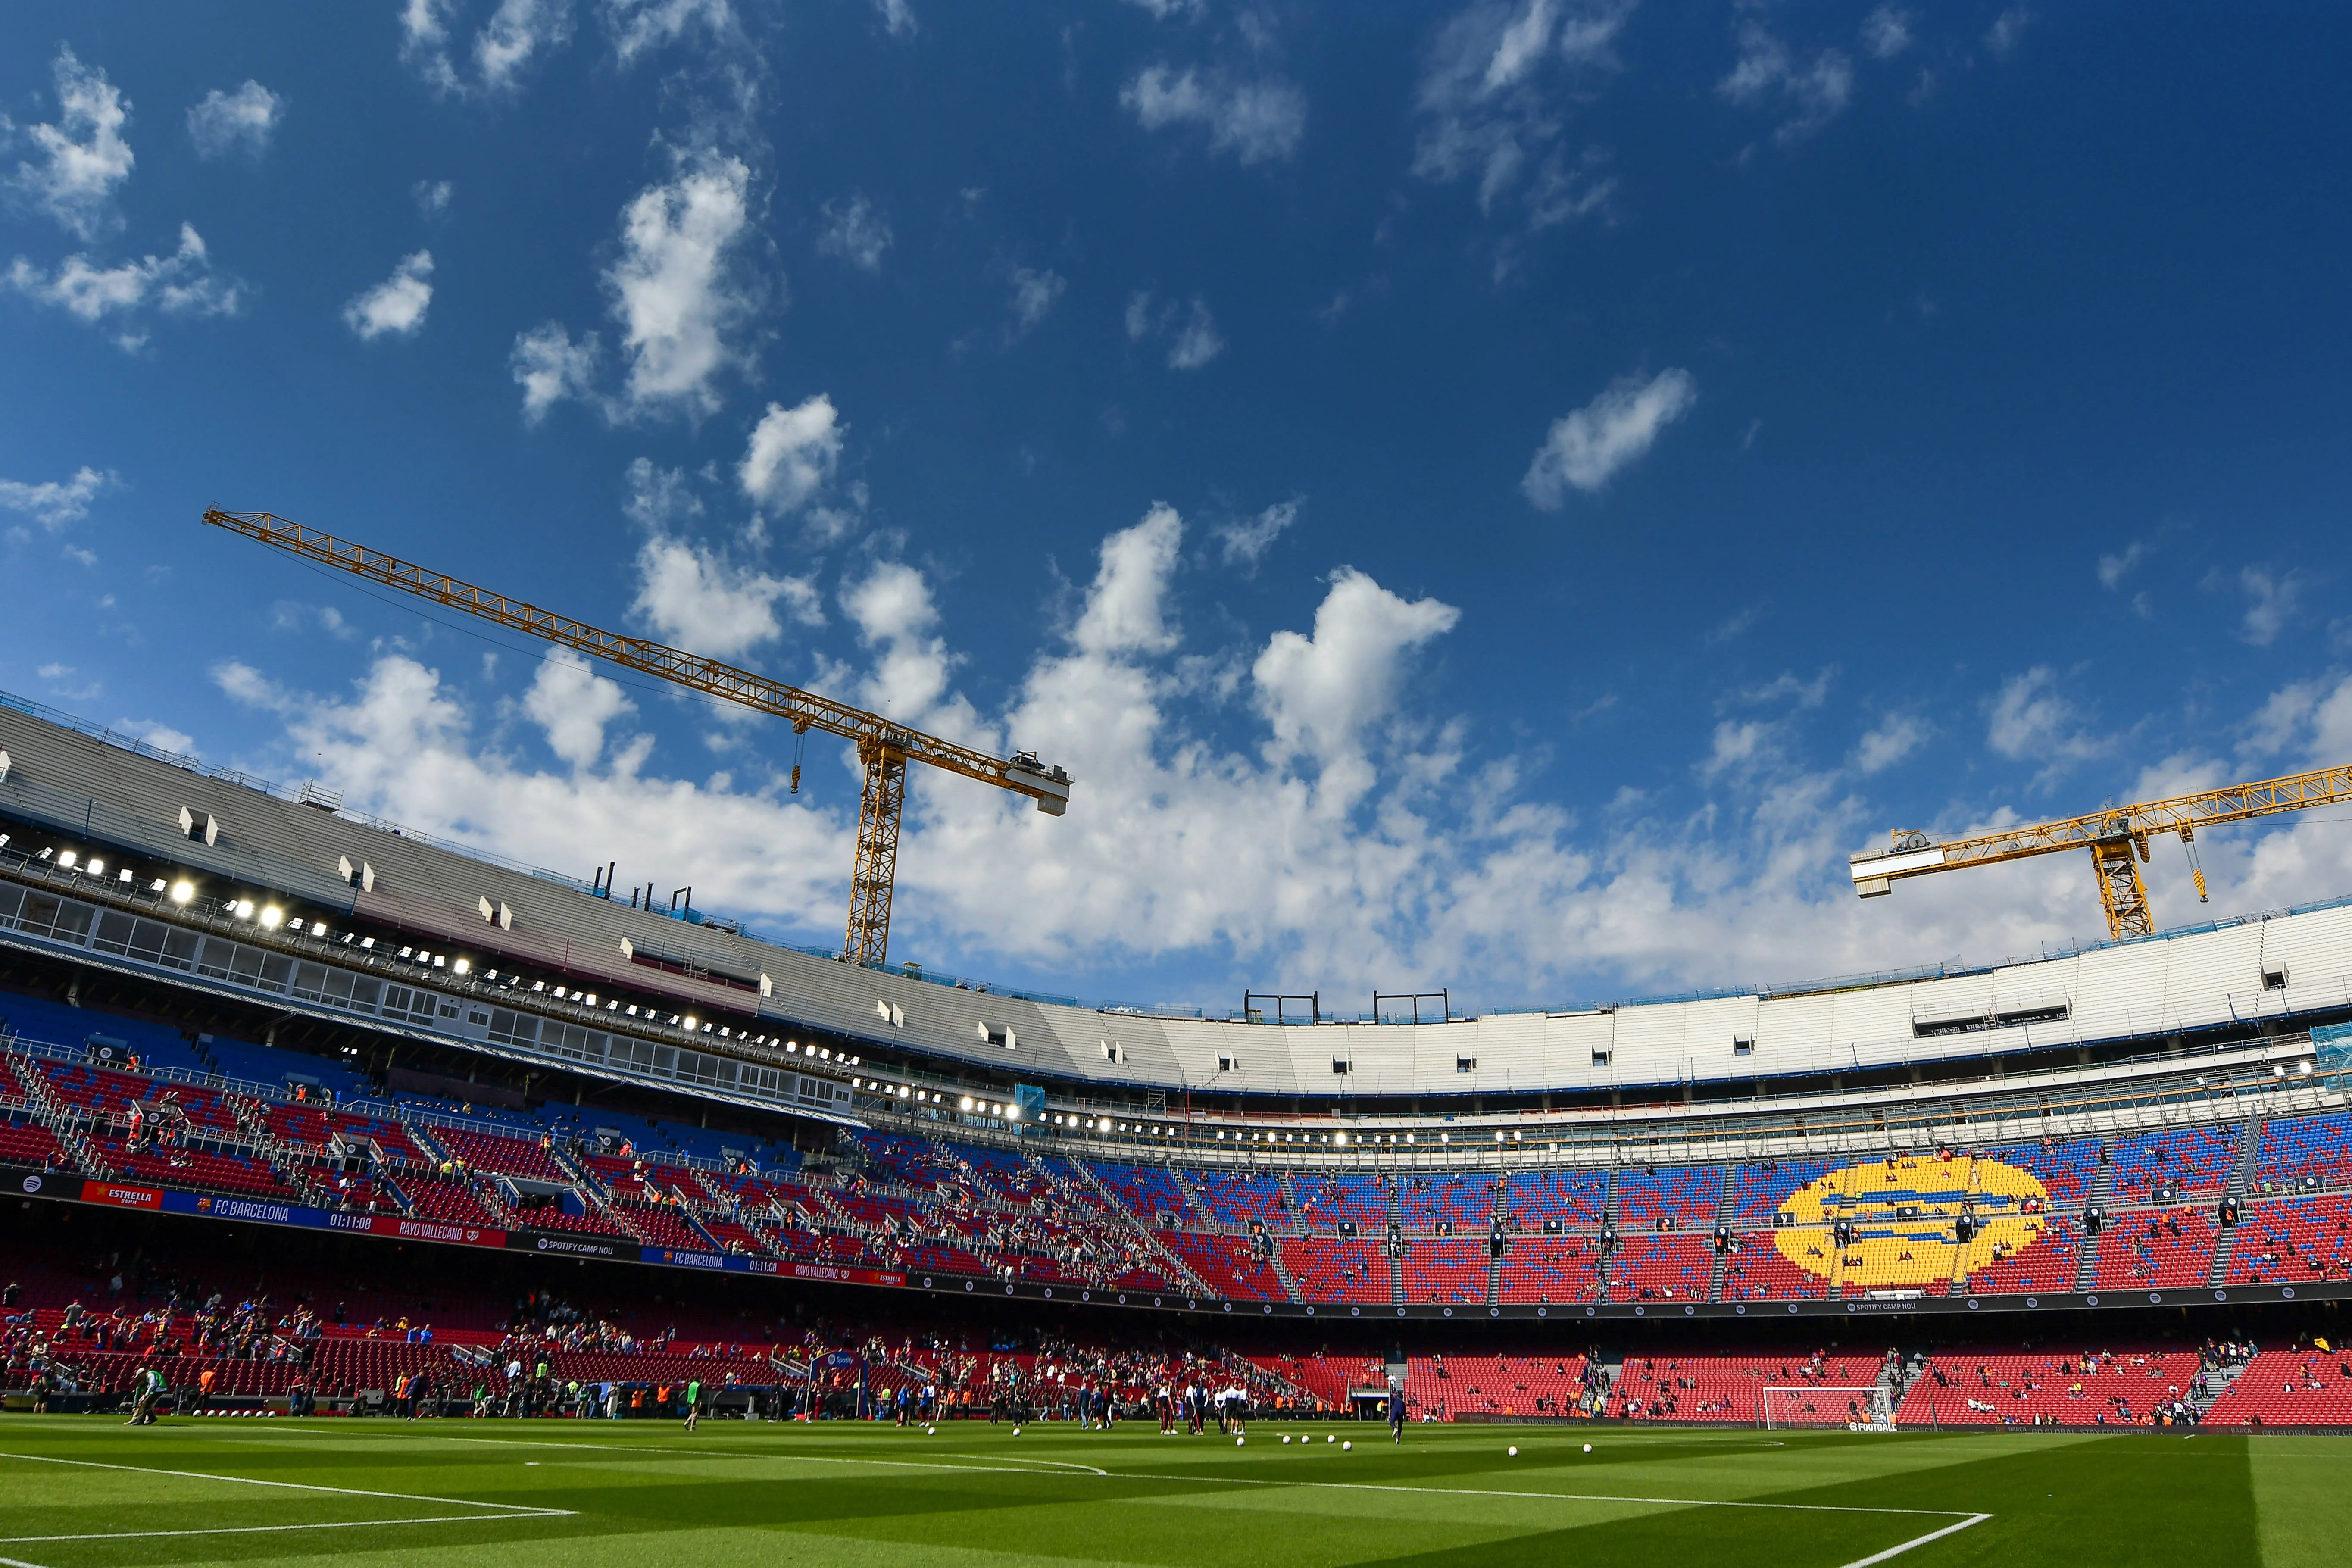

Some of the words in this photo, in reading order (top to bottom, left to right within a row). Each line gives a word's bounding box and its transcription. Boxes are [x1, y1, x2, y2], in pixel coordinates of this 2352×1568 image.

[109, 1189, 152, 1202] ESTRELLA
[215, 1199, 228, 1215] FC
[229, 1201, 289, 1221] BARCELONA
[330, 1214, 372, 1230] 01:11:08
[399, 1221, 420, 1236] RAYO
[421, 1224, 462, 1241] VALLECANO
[548, 1240, 578, 1251] SPOTIFY
[578, 1244, 598, 1253] CAMP
[675, 1252, 684, 1264] FC
[684, 1253, 723, 1268] BARCELONA
[750, 1260, 777, 1272] 01:11:08
[796, 1265, 809, 1276] RAYO
[811, 1266, 838, 1279] VALLECANO
[836, 1356, 853, 1365] Spotify
